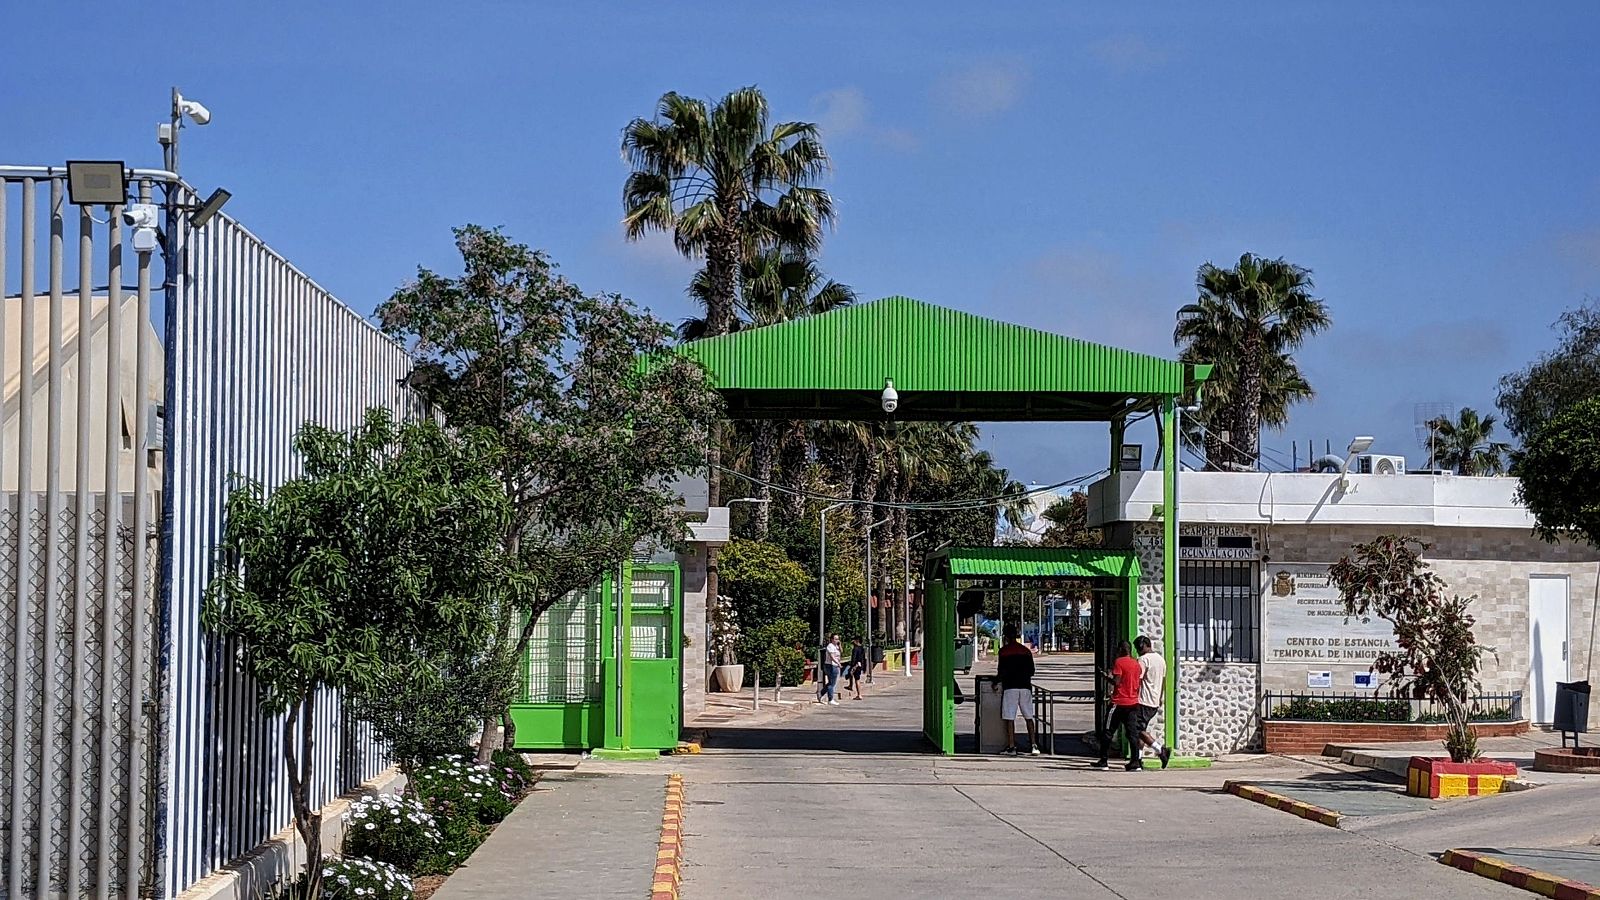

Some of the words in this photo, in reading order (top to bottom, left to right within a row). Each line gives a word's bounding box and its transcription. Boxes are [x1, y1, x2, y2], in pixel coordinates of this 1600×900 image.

[1184, 526, 1236, 536] CARRETERA
[1204, 537, 1216, 547] DE
[1181, 548, 1250, 558] RCUNVALACION
[1287, 638, 1325, 646] CENTRO
[1328, 639, 1341, 647] DE
[1344, 639, 1390, 647] ESTANCIA
[1273, 649, 1324, 658] TEMPORAL
[1327, 650, 1340, 658] DE
